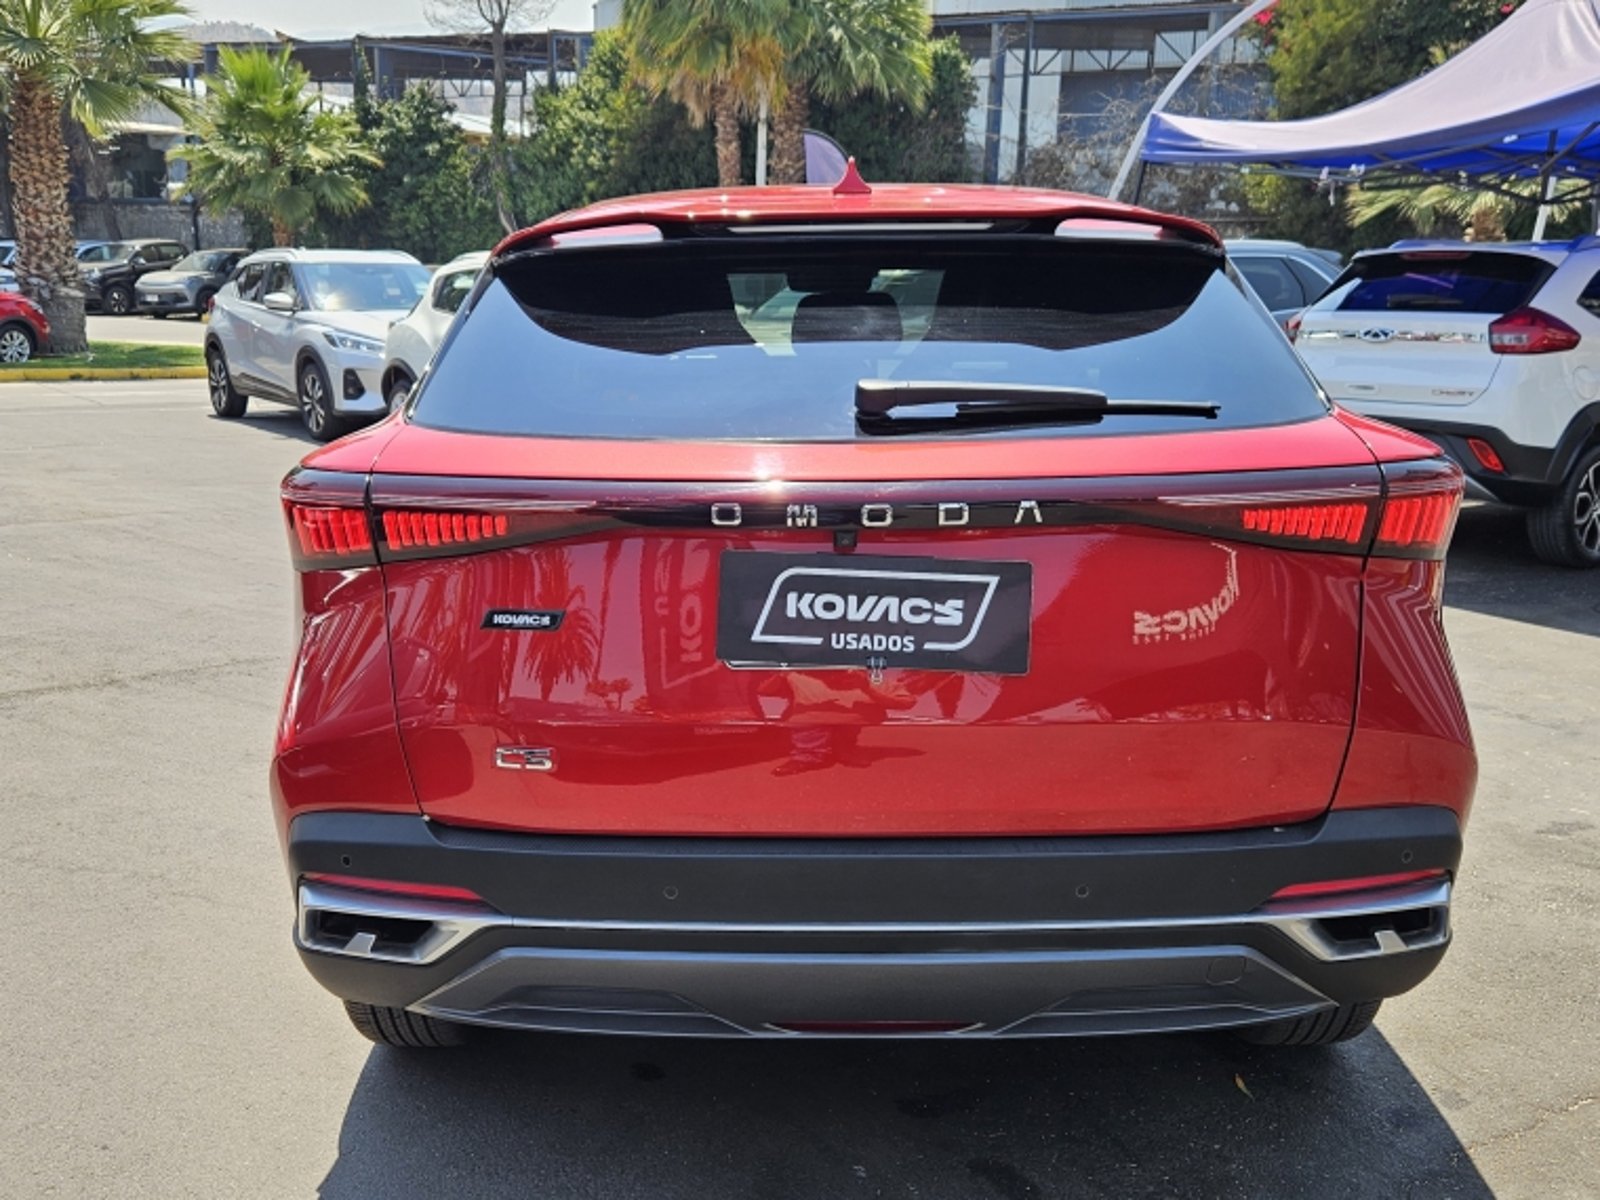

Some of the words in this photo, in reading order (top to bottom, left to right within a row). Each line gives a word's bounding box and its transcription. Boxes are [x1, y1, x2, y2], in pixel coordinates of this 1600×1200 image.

[710, 500, 1044, 528] OMODA
[493, 613, 551, 626] KOVACS
[785, 592, 965, 627] KOVACS
[830, 632, 915, 652] USADOS
